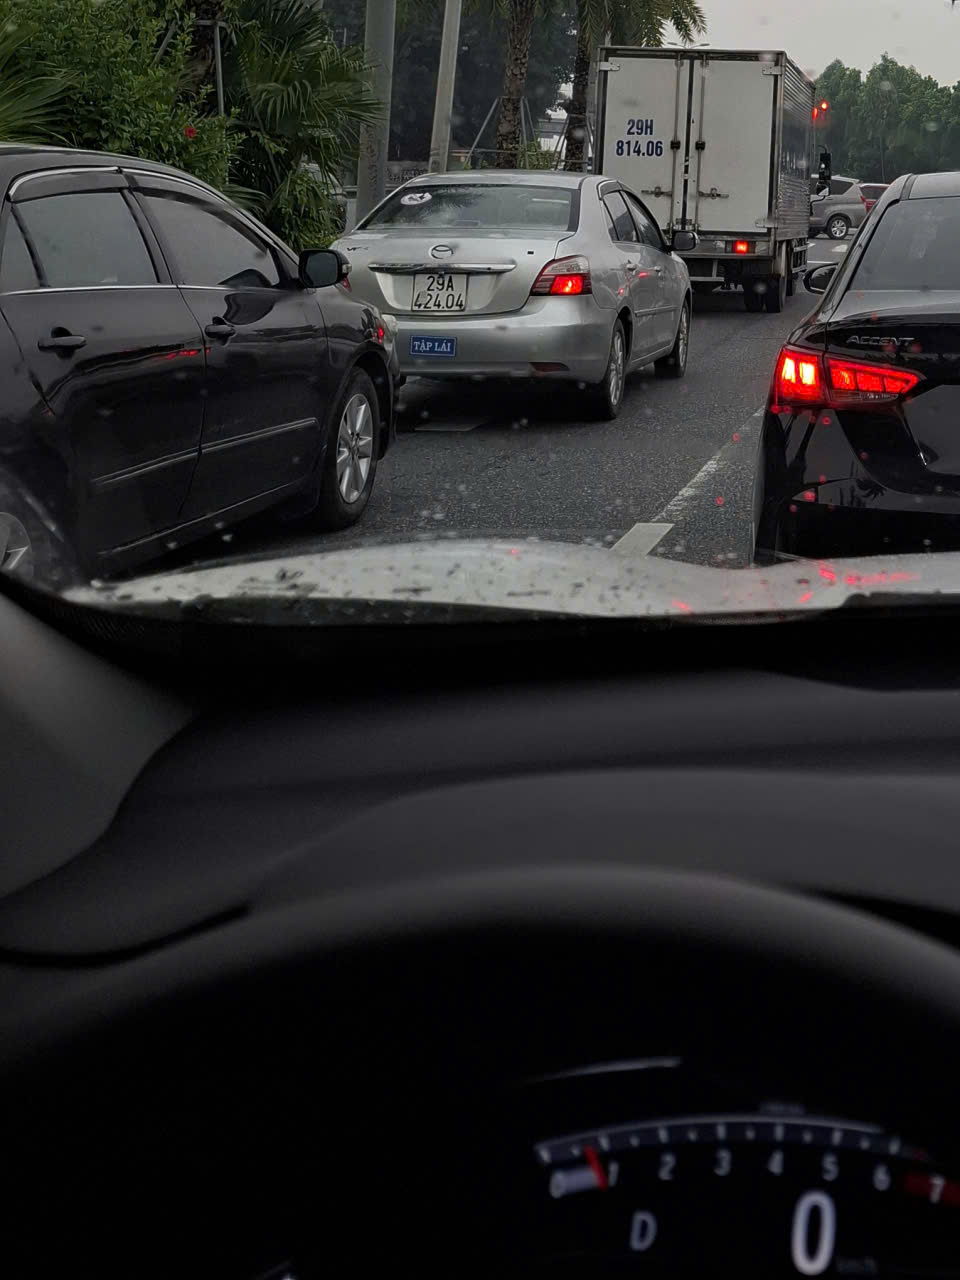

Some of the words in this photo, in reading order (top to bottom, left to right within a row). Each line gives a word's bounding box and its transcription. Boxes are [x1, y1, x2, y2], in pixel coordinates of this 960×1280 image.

[627, 119, 653, 135] 29H
[616, 140, 663, 157] 814.06
[427, 275, 454, 292] 29A
[414, 293, 464, 310] 424.04
[413, 340, 433, 352] TẬP
[434, 340, 452, 352] LÁI
[846, 335, 915, 347] ACCENT
[608, 1160, 620, 1187] 1
[659, 1153, 676, 1181] 2
[714, 1148, 732, 1176] 3
[768, 1150, 784, 1176] 4
[822, 1153, 839, 1181] 5
[873, 1163, 891, 1191] 6
[928, 1175, 945, 1203] 7
[629, 1210, 657, 1251] D
[791, 1190, 836, 1276] 0
